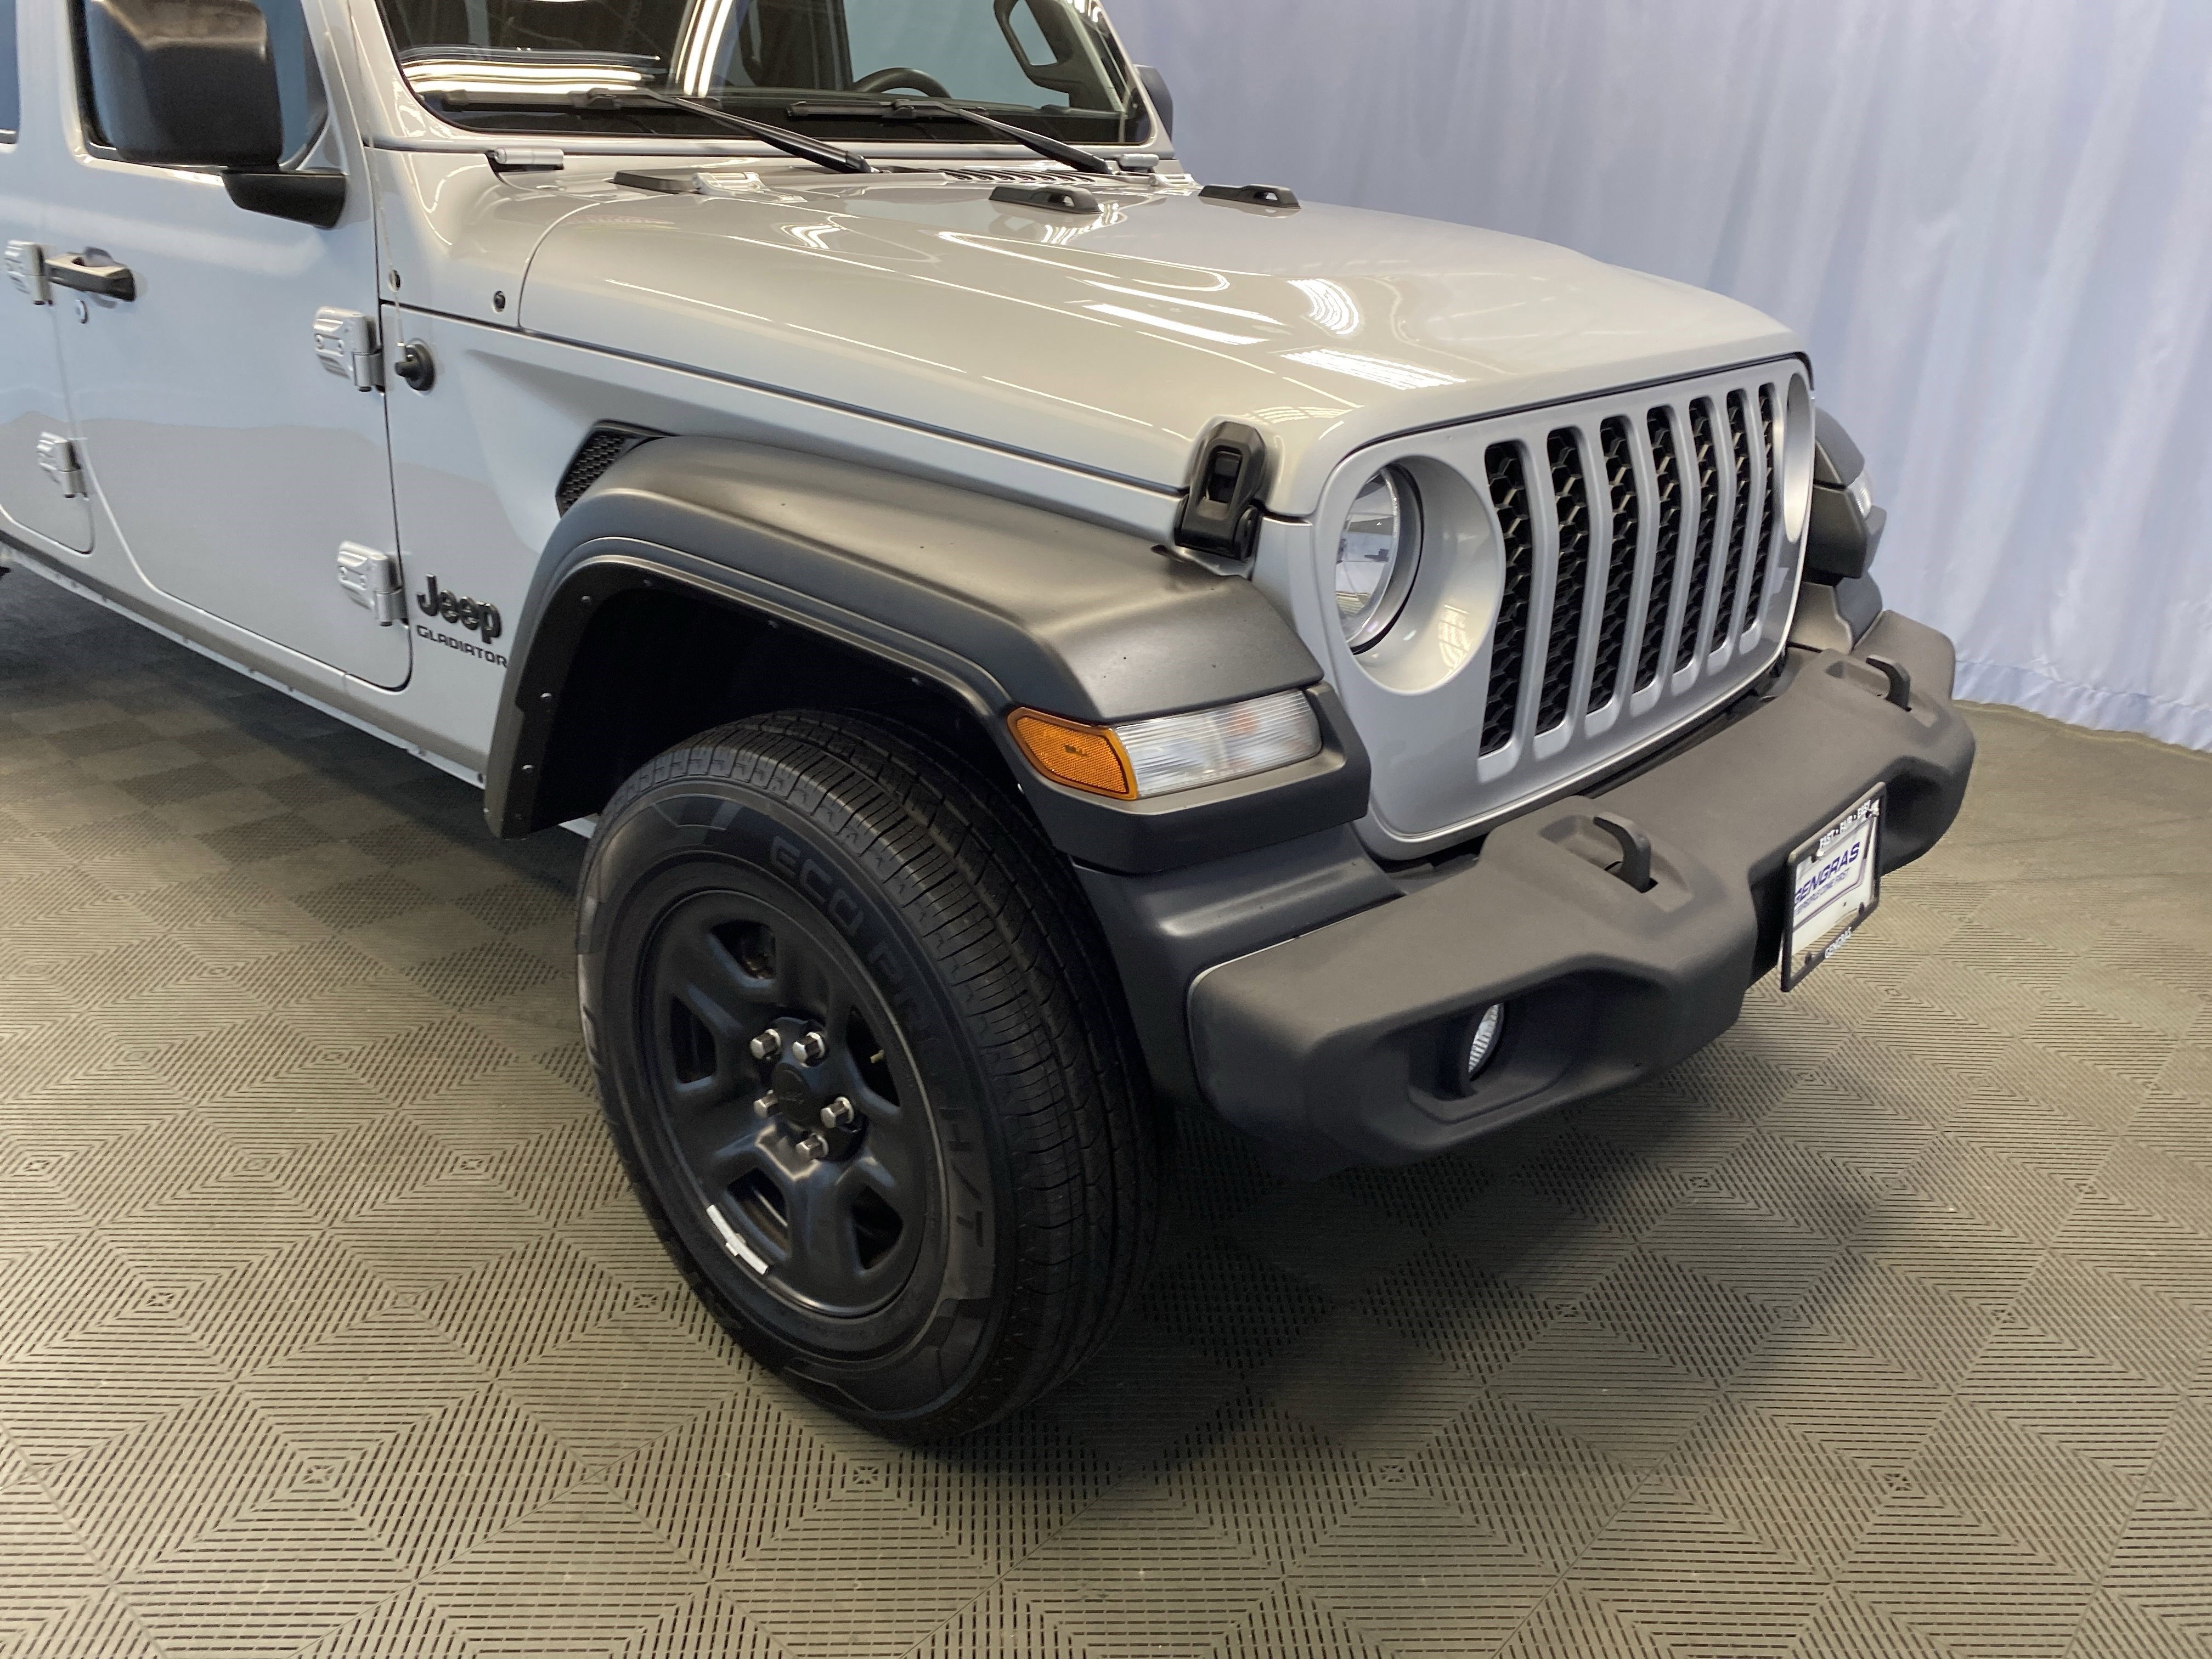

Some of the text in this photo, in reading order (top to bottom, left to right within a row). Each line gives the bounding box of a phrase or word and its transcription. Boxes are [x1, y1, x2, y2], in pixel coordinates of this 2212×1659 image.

[416, 573, 502, 644] Jeep
[417, 624, 507, 667] GLADIATOR
[770, 836, 865, 936] ECO
[1794, 842, 1860, 905] GENGRAS
